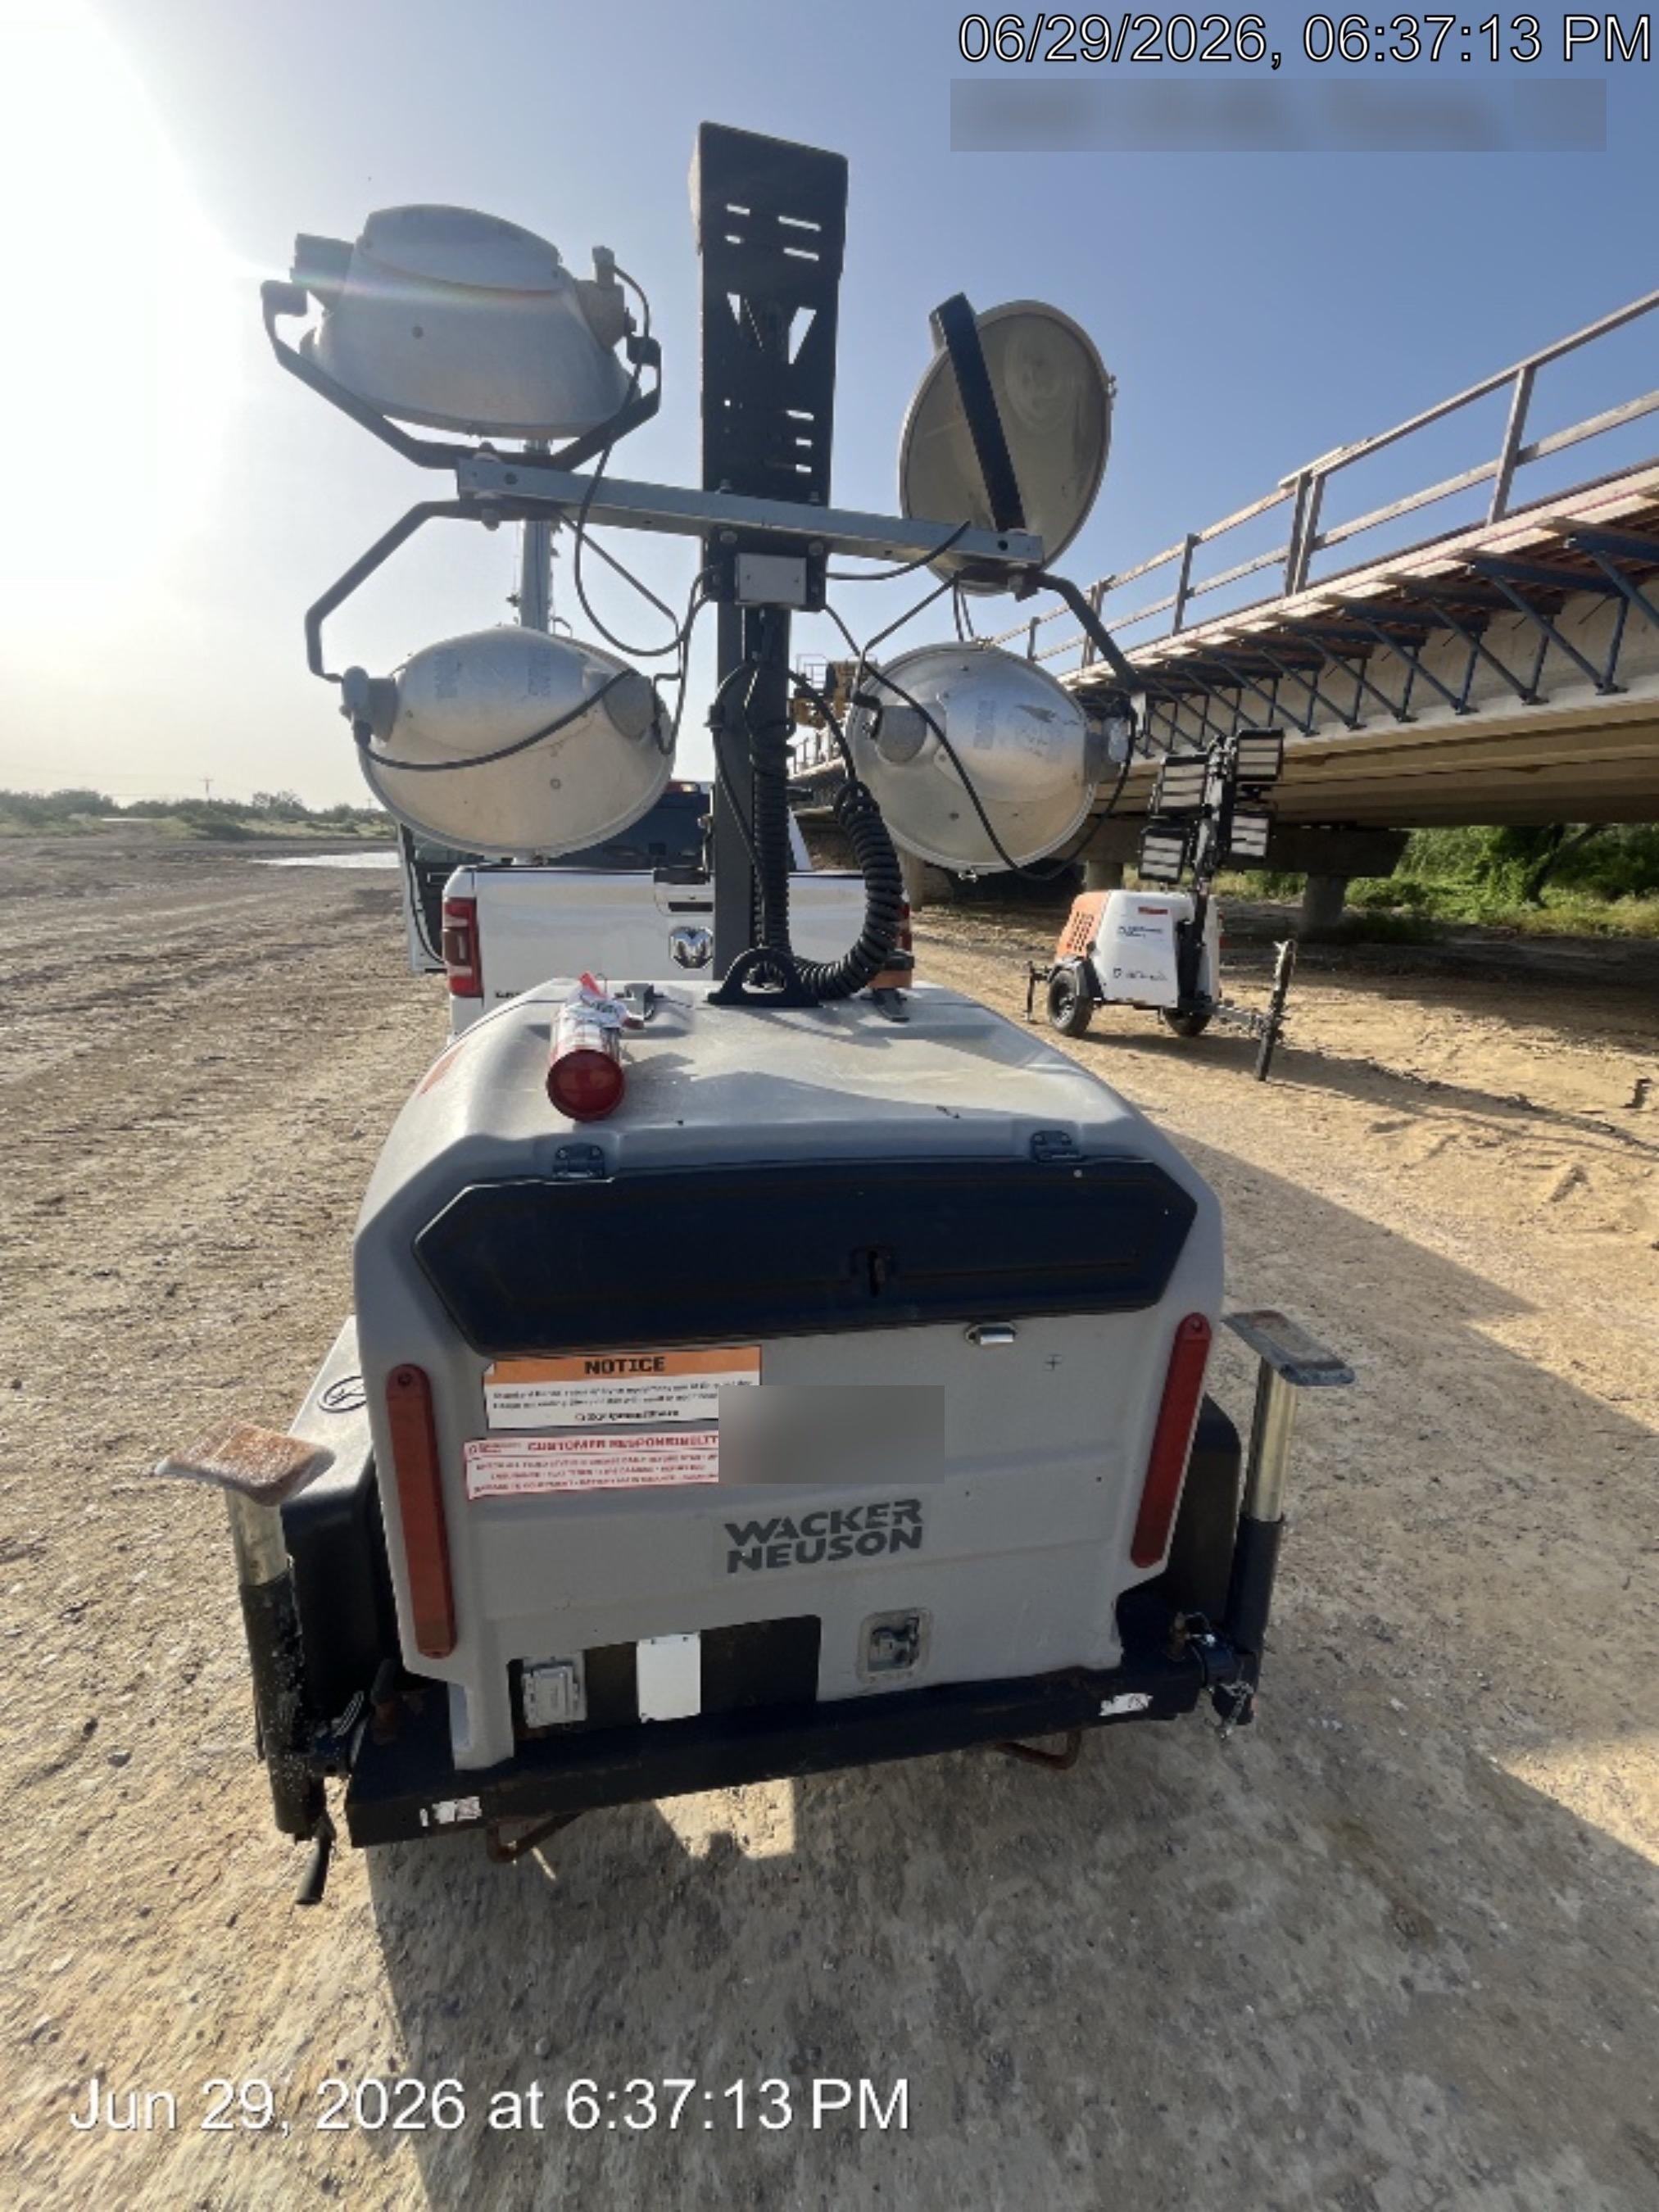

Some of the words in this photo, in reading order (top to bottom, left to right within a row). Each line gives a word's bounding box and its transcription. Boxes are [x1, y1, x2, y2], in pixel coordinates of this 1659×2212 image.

[584, 1356, 665, 1374] NOTICE
[724, 1498, 924, 1547] WACKER
[727, 1525, 922, 1574] NEUSON
